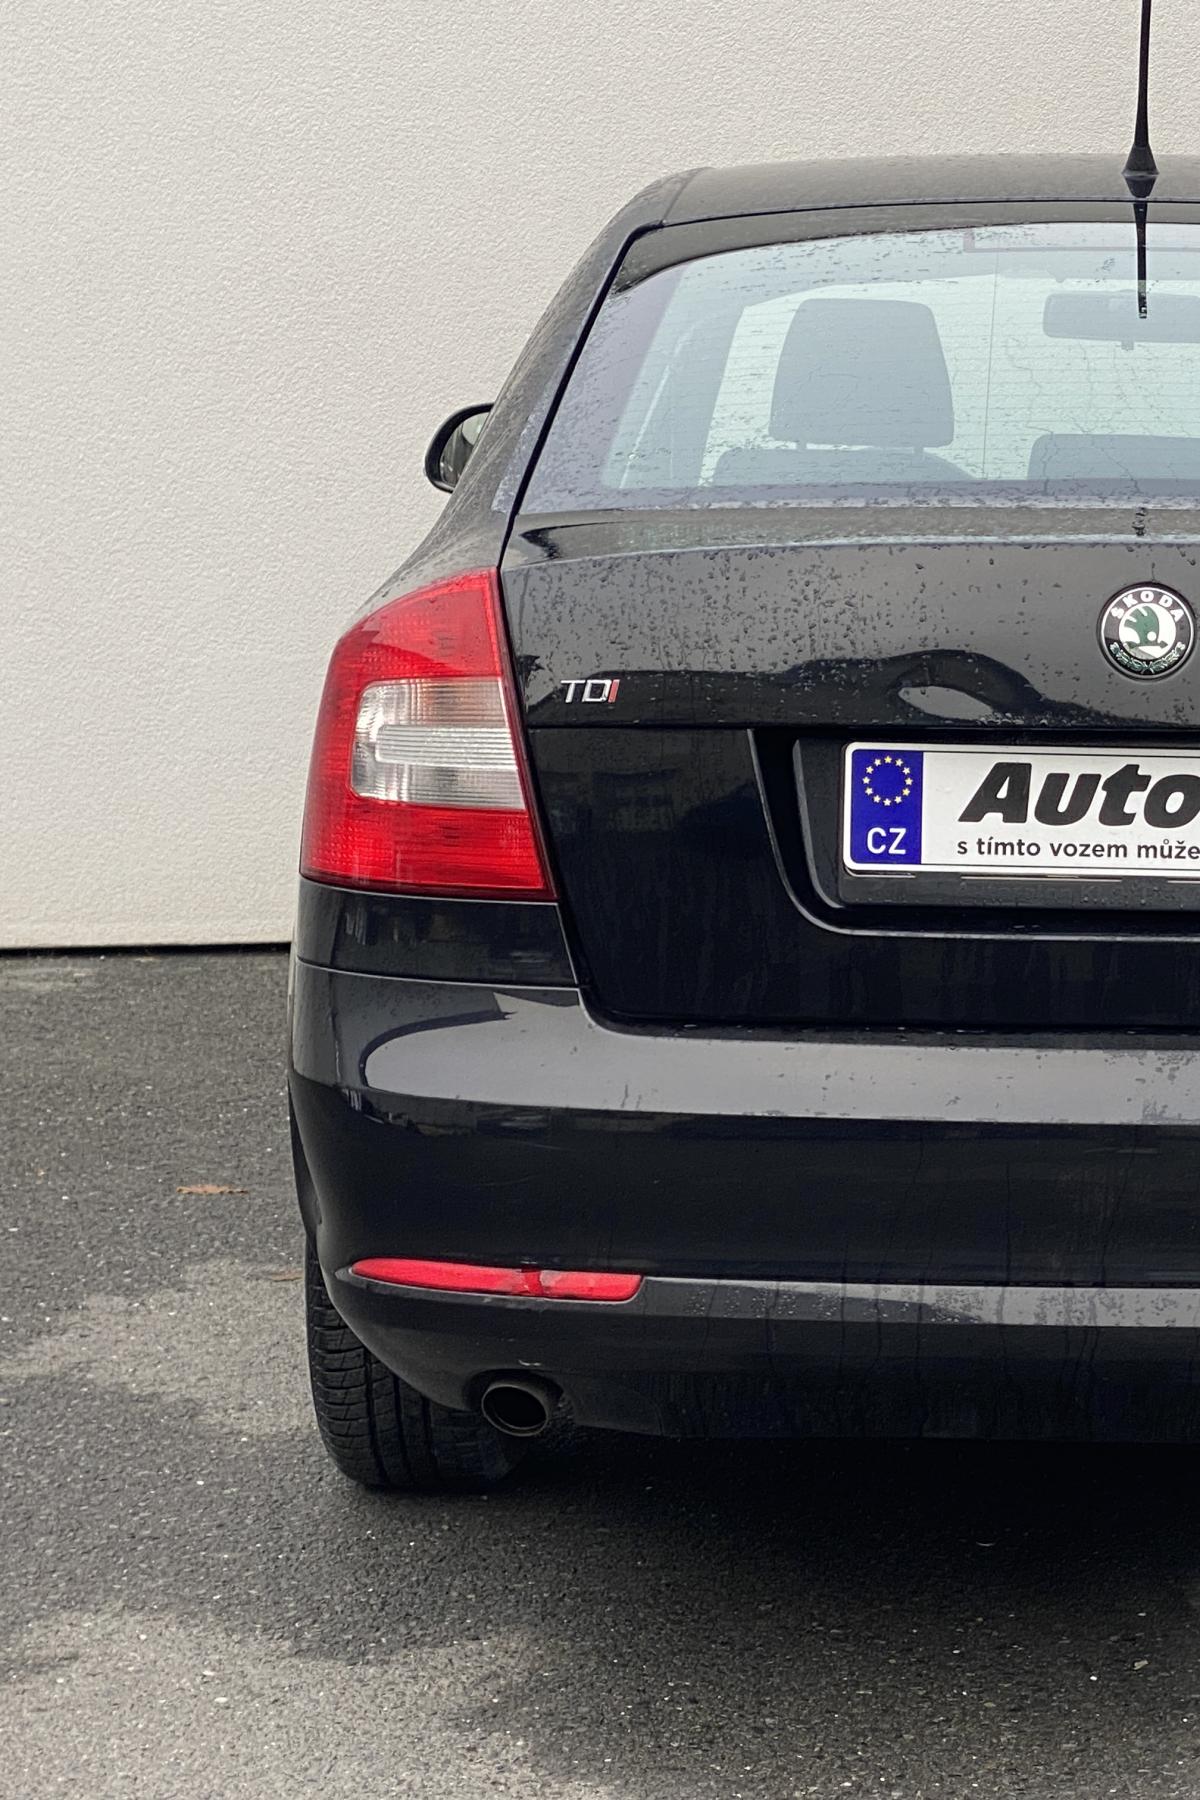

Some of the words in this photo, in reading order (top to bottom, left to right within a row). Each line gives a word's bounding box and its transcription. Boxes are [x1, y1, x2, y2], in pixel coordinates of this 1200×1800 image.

[866, 826, 907, 855] CZ
[957, 841, 968, 855] s
[976, 836, 1041, 857] tímto
[1049, 843, 1128, 858] vozem
